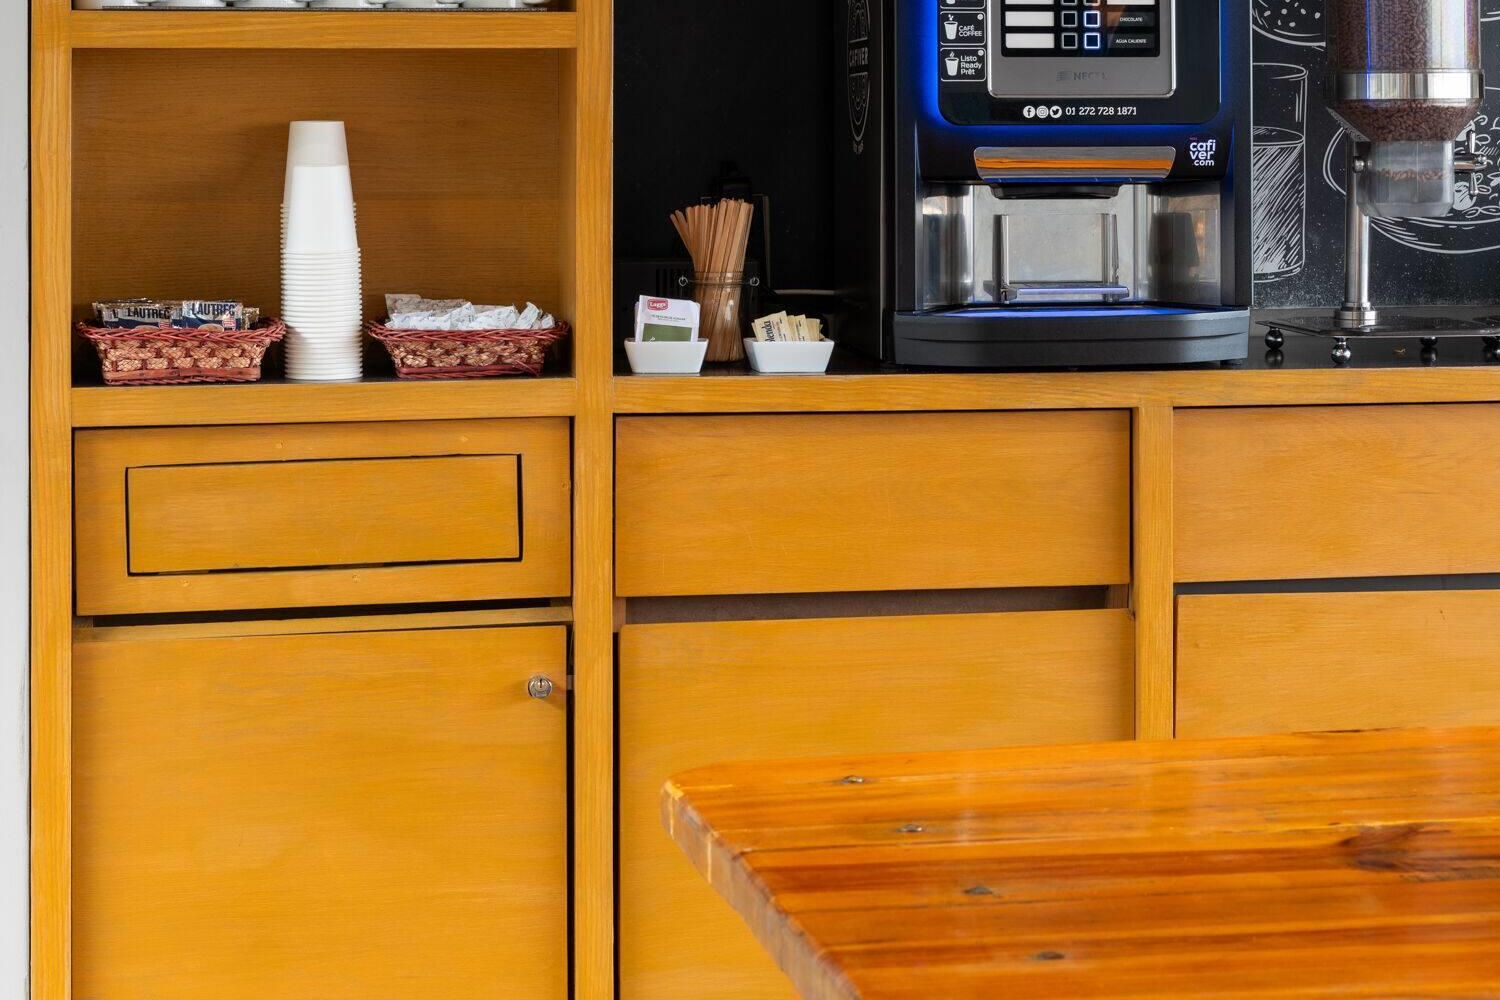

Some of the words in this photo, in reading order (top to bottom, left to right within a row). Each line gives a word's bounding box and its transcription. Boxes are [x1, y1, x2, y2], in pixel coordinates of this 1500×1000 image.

[1066, 107, 1075, 115] 01
[1079, 107, 1095, 115] 272
[1098, 107, 1114, 115] 728
[1117, 107, 1136, 115] 1871
[1190, 139, 1216, 151] cafi
[1190, 151, 1214, 159] ver
[128, 307, 170, 320] LAUTREC
[192, 303, 235, 316] LAUTREC
